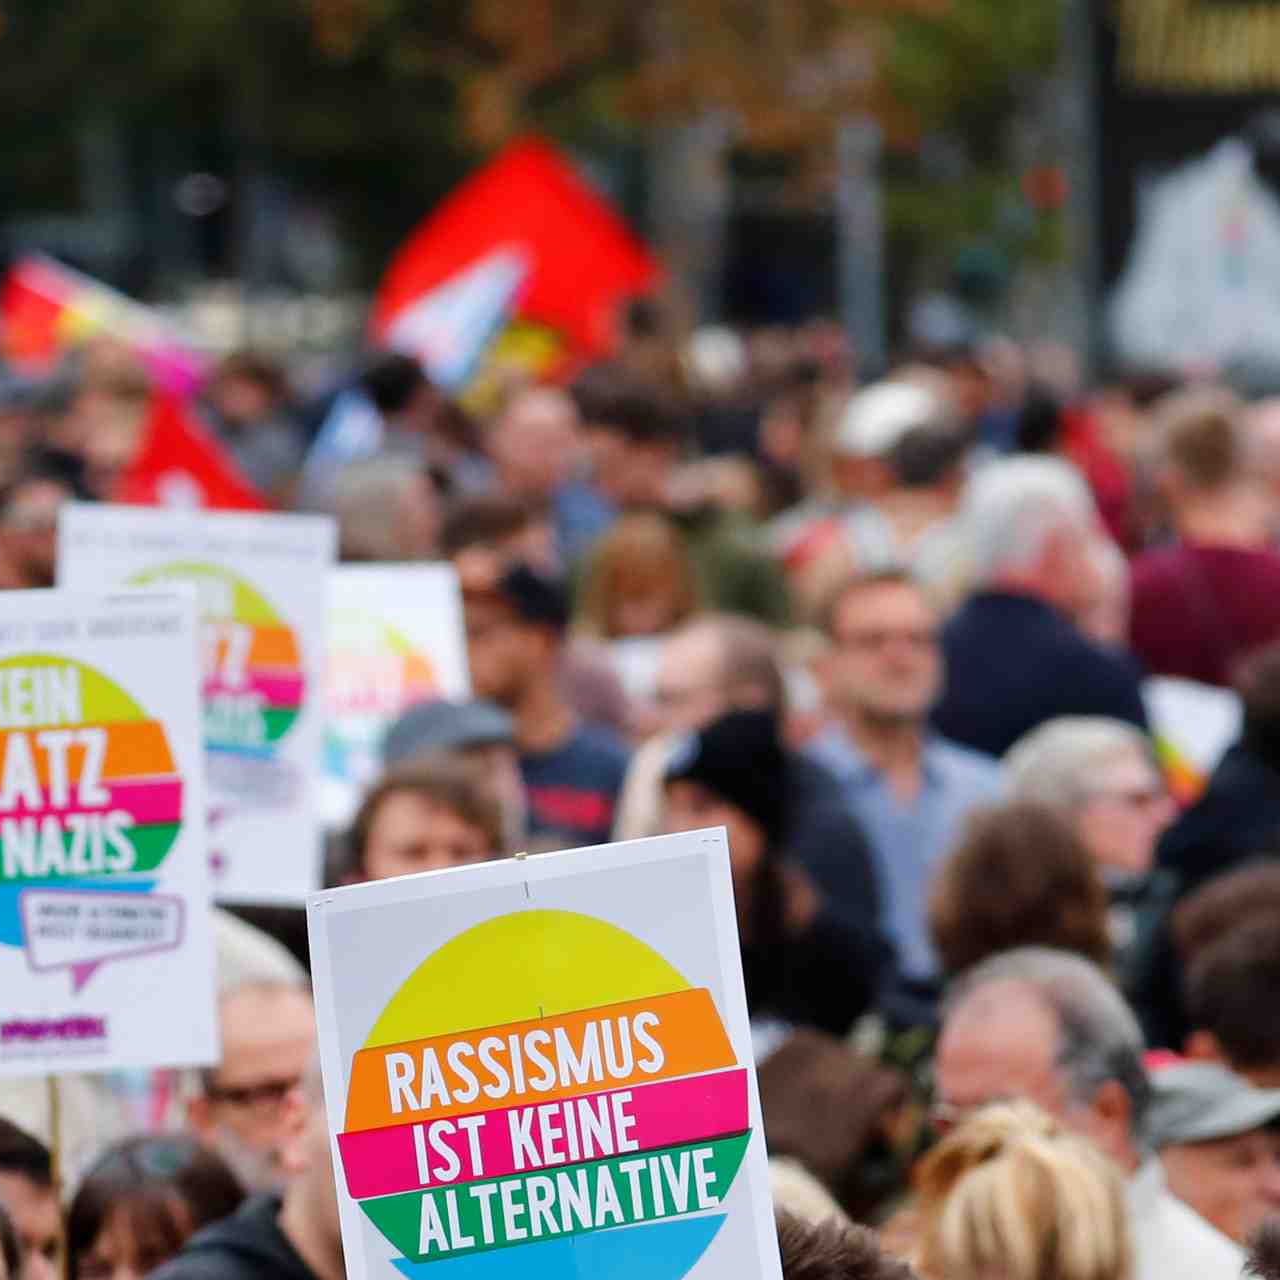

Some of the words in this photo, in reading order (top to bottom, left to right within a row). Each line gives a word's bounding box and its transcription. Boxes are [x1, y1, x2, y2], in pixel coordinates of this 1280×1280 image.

[384, 1011, 666, 1115] RASSISMUS
[412, 1114, 487, 1185] IST
[506, 1090, 641, 1171] KEINE
[417, 1146, 721, 1256] ALTERNATIVE
